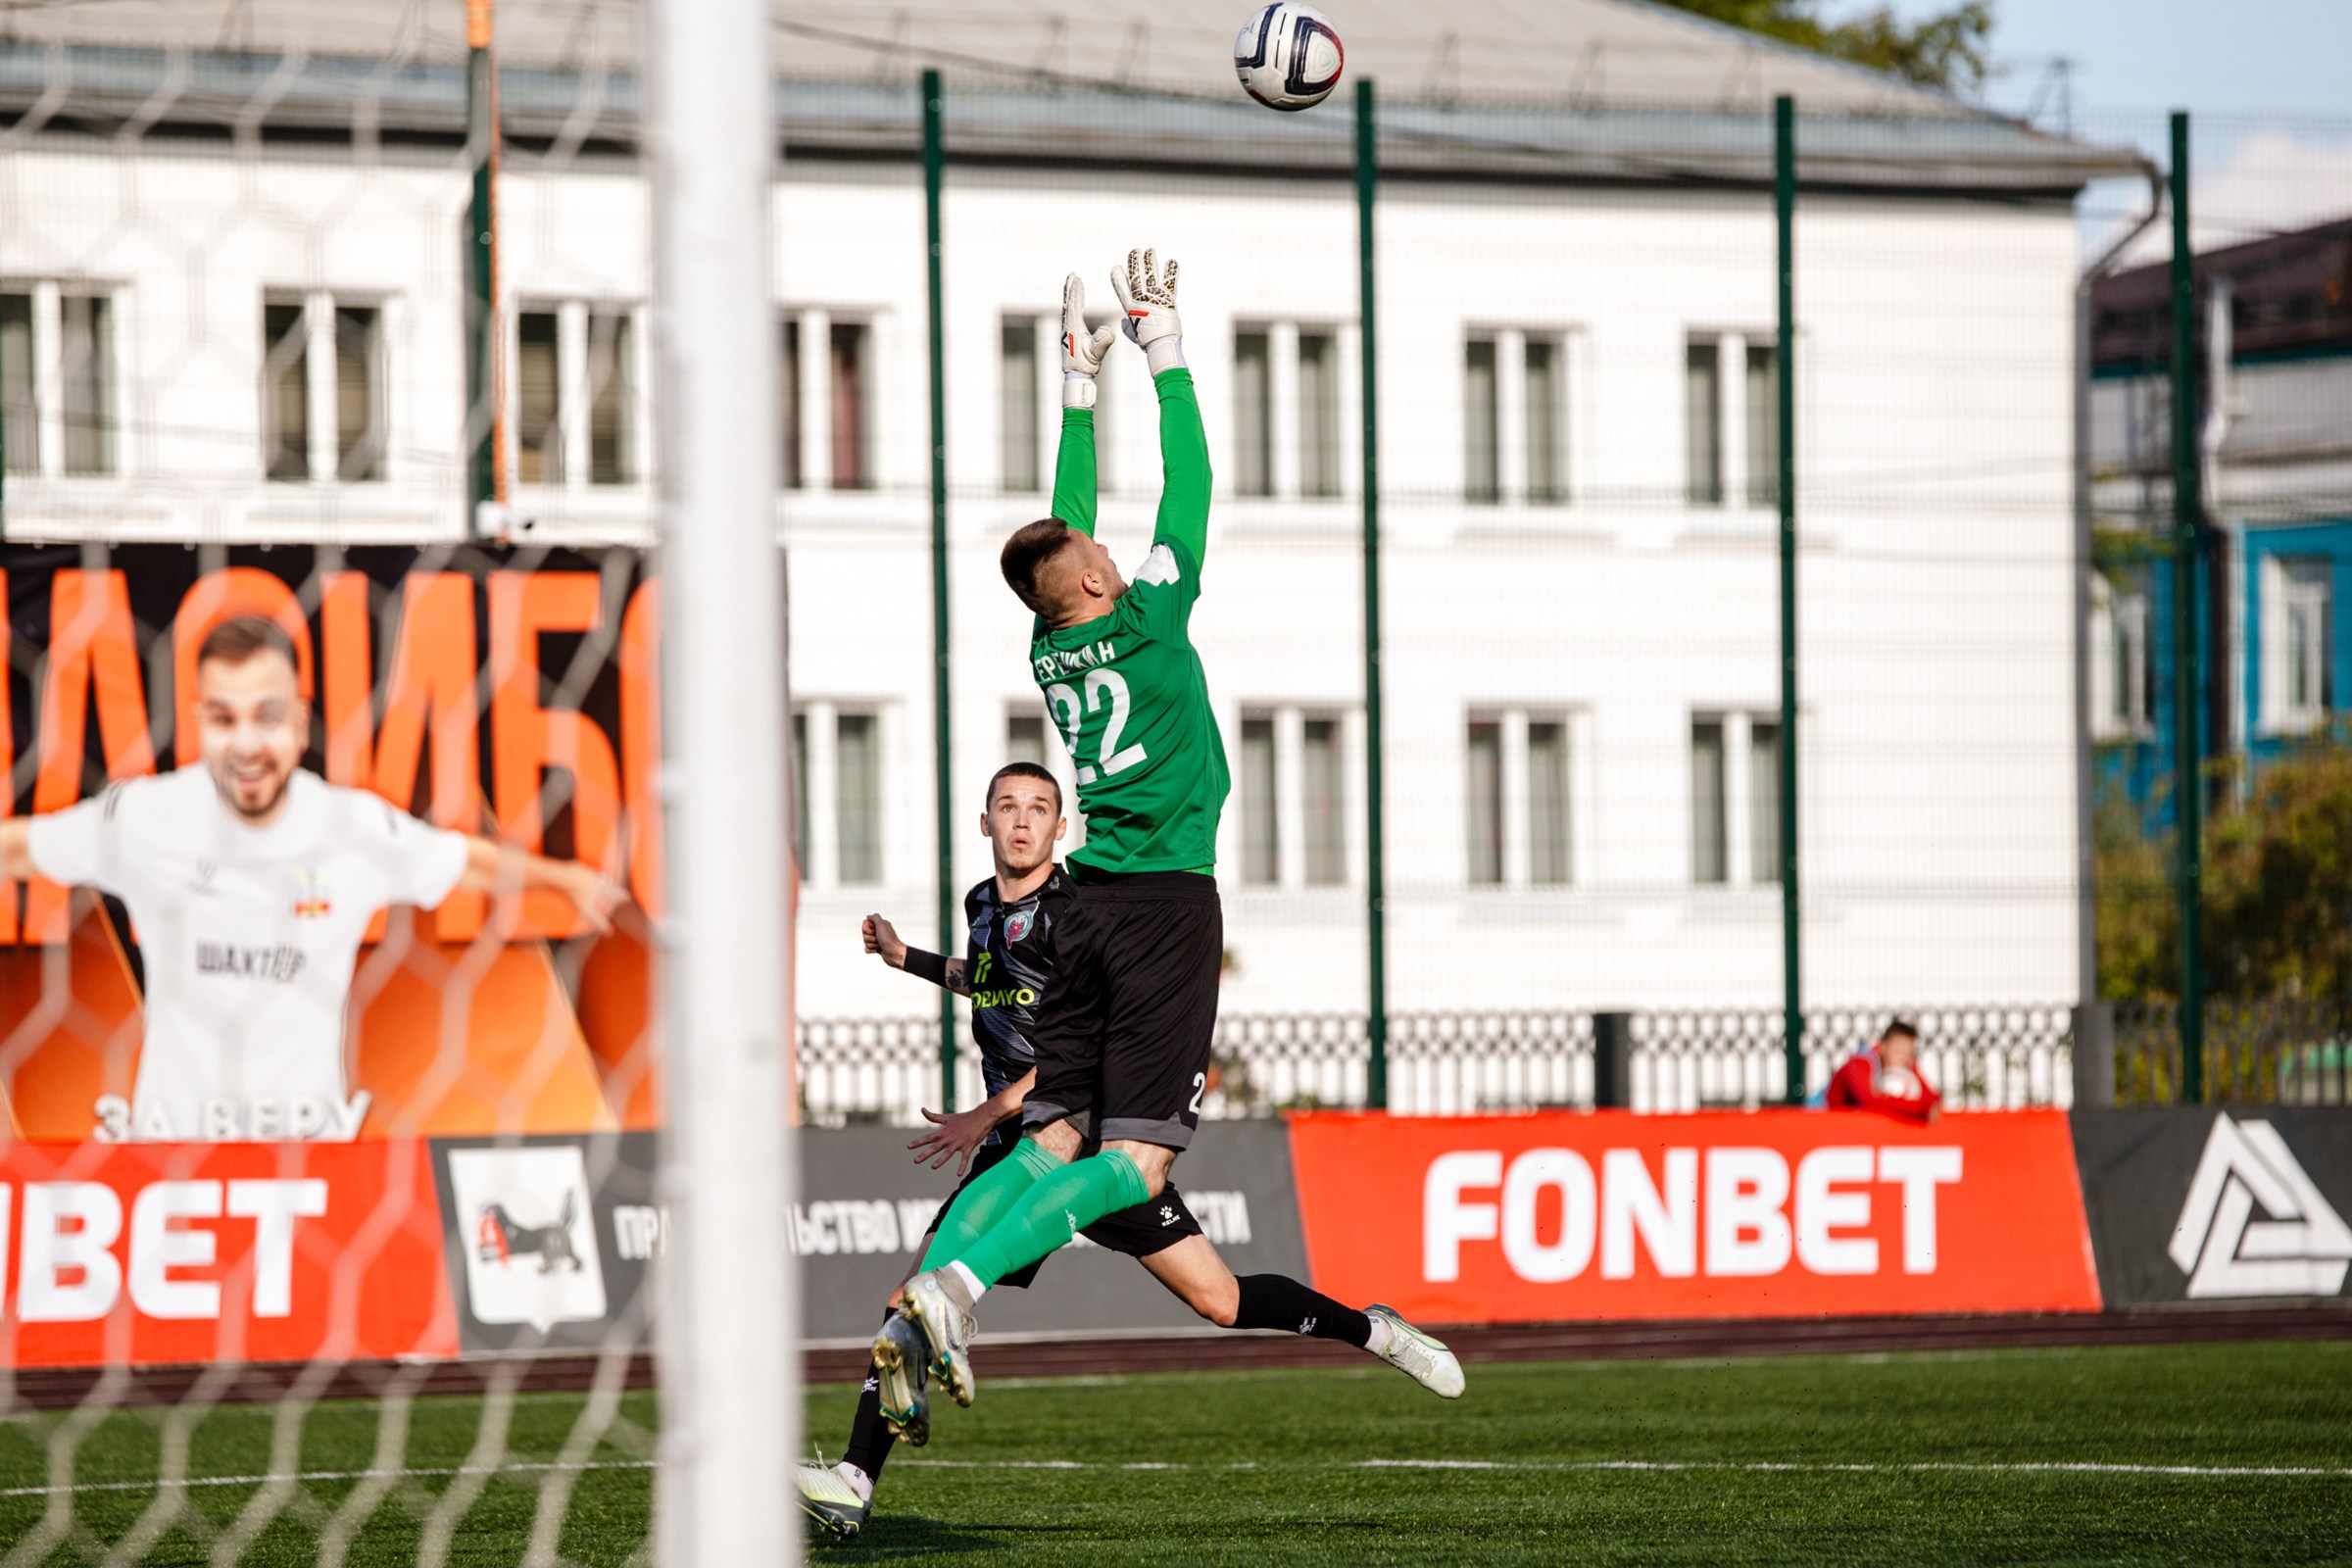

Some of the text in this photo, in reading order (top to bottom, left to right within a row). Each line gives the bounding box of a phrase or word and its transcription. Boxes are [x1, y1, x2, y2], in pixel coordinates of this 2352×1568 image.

[1046, 668, 1148, 785] 22
[201, 1090, 372, 1143] ВЕРУ
[0, 1180, 328, 1323] BET
[1161, 1214, 1181, 1226] KELME
[1424, 1146, 1962, 1283] FONBET
